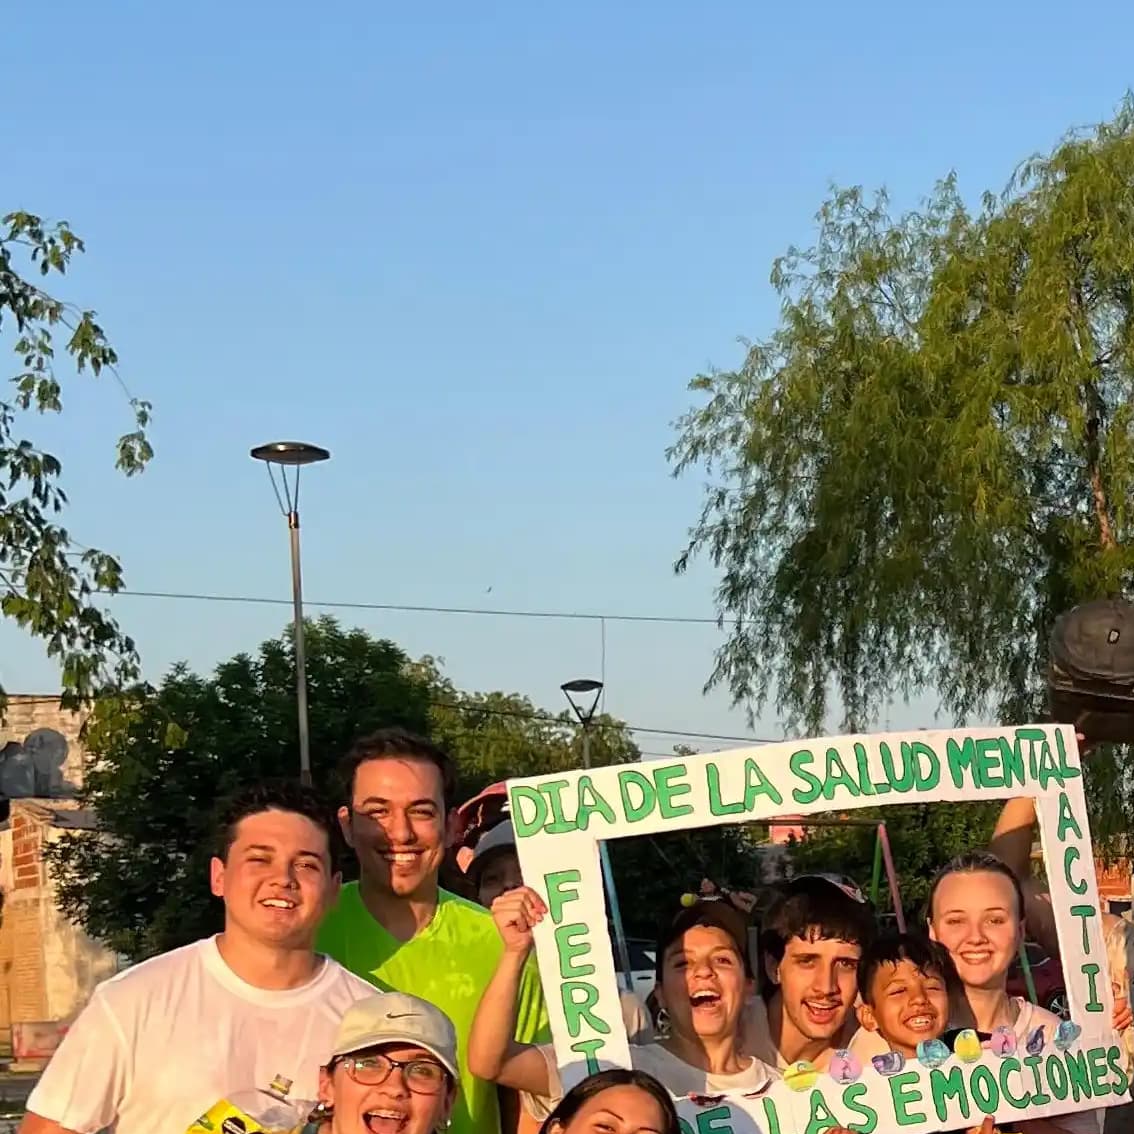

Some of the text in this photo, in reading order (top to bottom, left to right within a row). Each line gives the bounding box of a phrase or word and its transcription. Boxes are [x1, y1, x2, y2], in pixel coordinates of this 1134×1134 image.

[511, 728, 1081, 838] DIA DE LA SALUD MENTAL
[889, 1045, 1129, 1127] EMOCIONES
